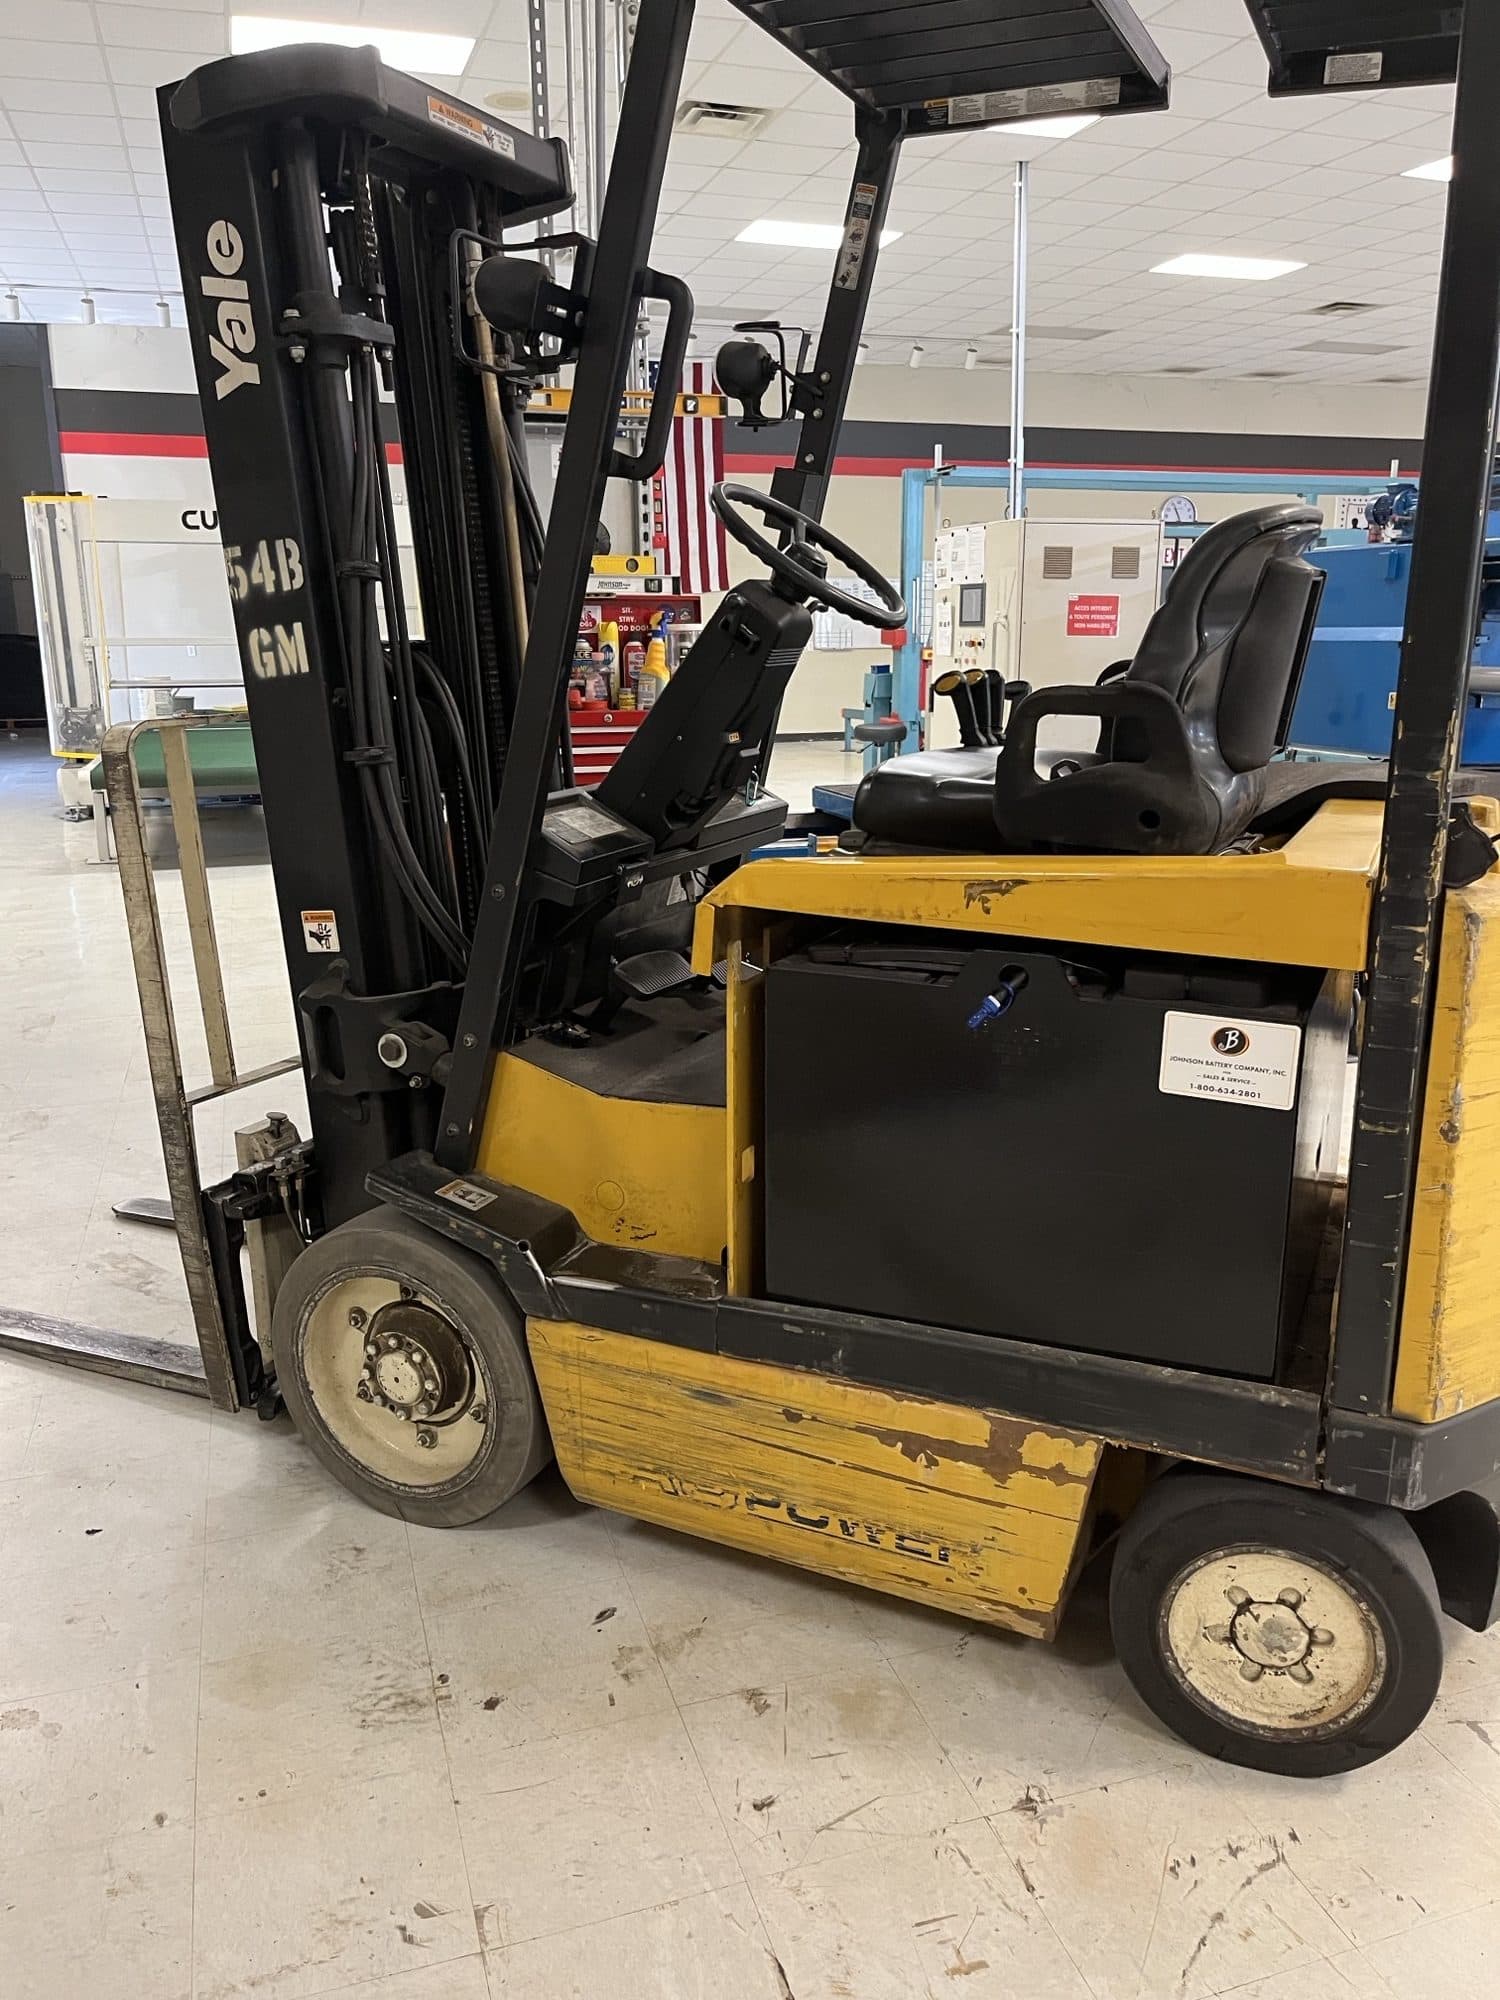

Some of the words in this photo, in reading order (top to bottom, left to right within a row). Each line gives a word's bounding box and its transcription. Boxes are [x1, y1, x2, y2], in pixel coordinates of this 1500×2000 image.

[200, 219, 261, 401] Yale
[618, 615, 637, 623] STAY.
[248, 621, 310, 679] GM
[1169, 1055, 1204, 1066] JOHNSON
[1205, 1060, 1233, 1069] BATTERY
[1233, 1064, 1272, 1076] COMPANY,
[1272, 1069, 1288, 1077] INC.
[1202, 1073, 1220, 1081] SALES
[1227, 1077, 1251, 1086] SERVICE
[1189, 1082, 1262, 1099] 1-800-634-2801
